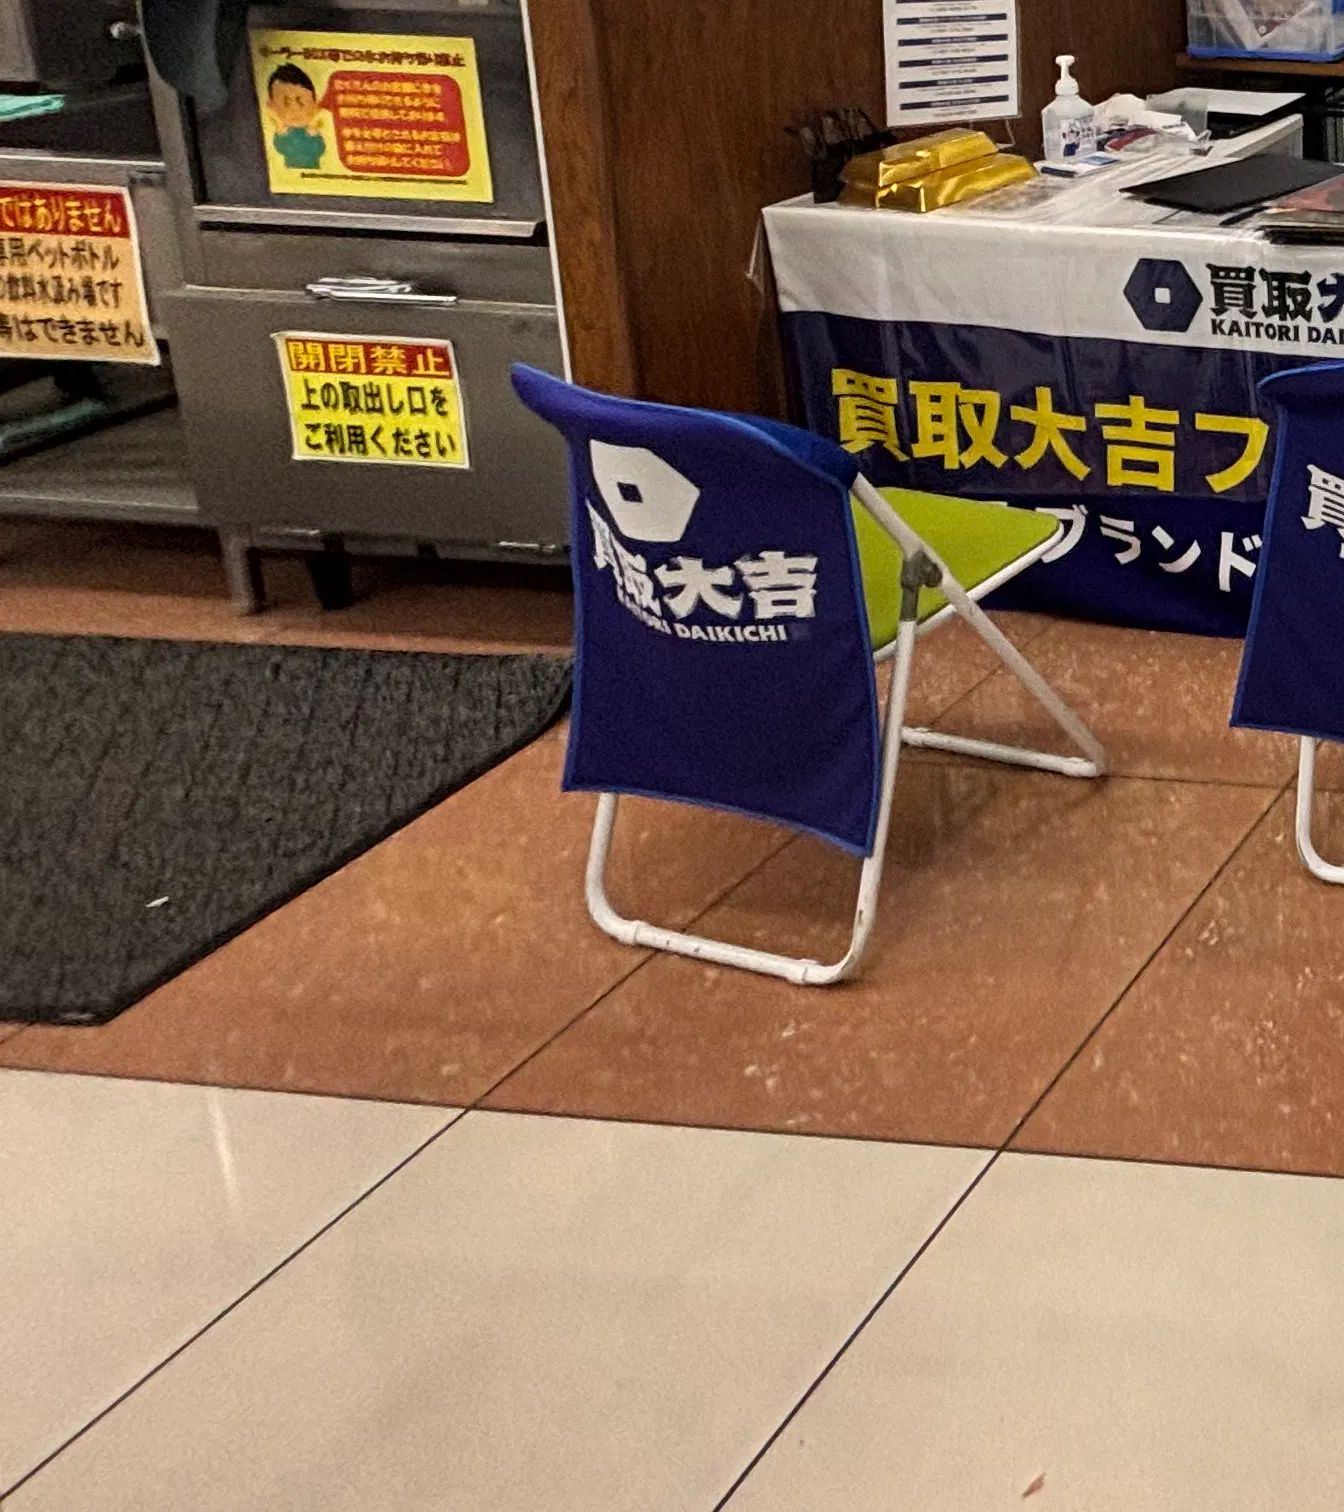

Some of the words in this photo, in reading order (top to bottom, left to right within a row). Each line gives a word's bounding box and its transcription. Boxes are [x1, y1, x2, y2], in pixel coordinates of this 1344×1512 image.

[1211, 317, 1300, 343] KAITORI
[287, 341, 450, 376] 開閉禁止
[301, 377, 449, 417] 上の取出し口を
[304, 422, 457, 458] ご利用ください
[674, 623, 789, 642] DAIKICHI
